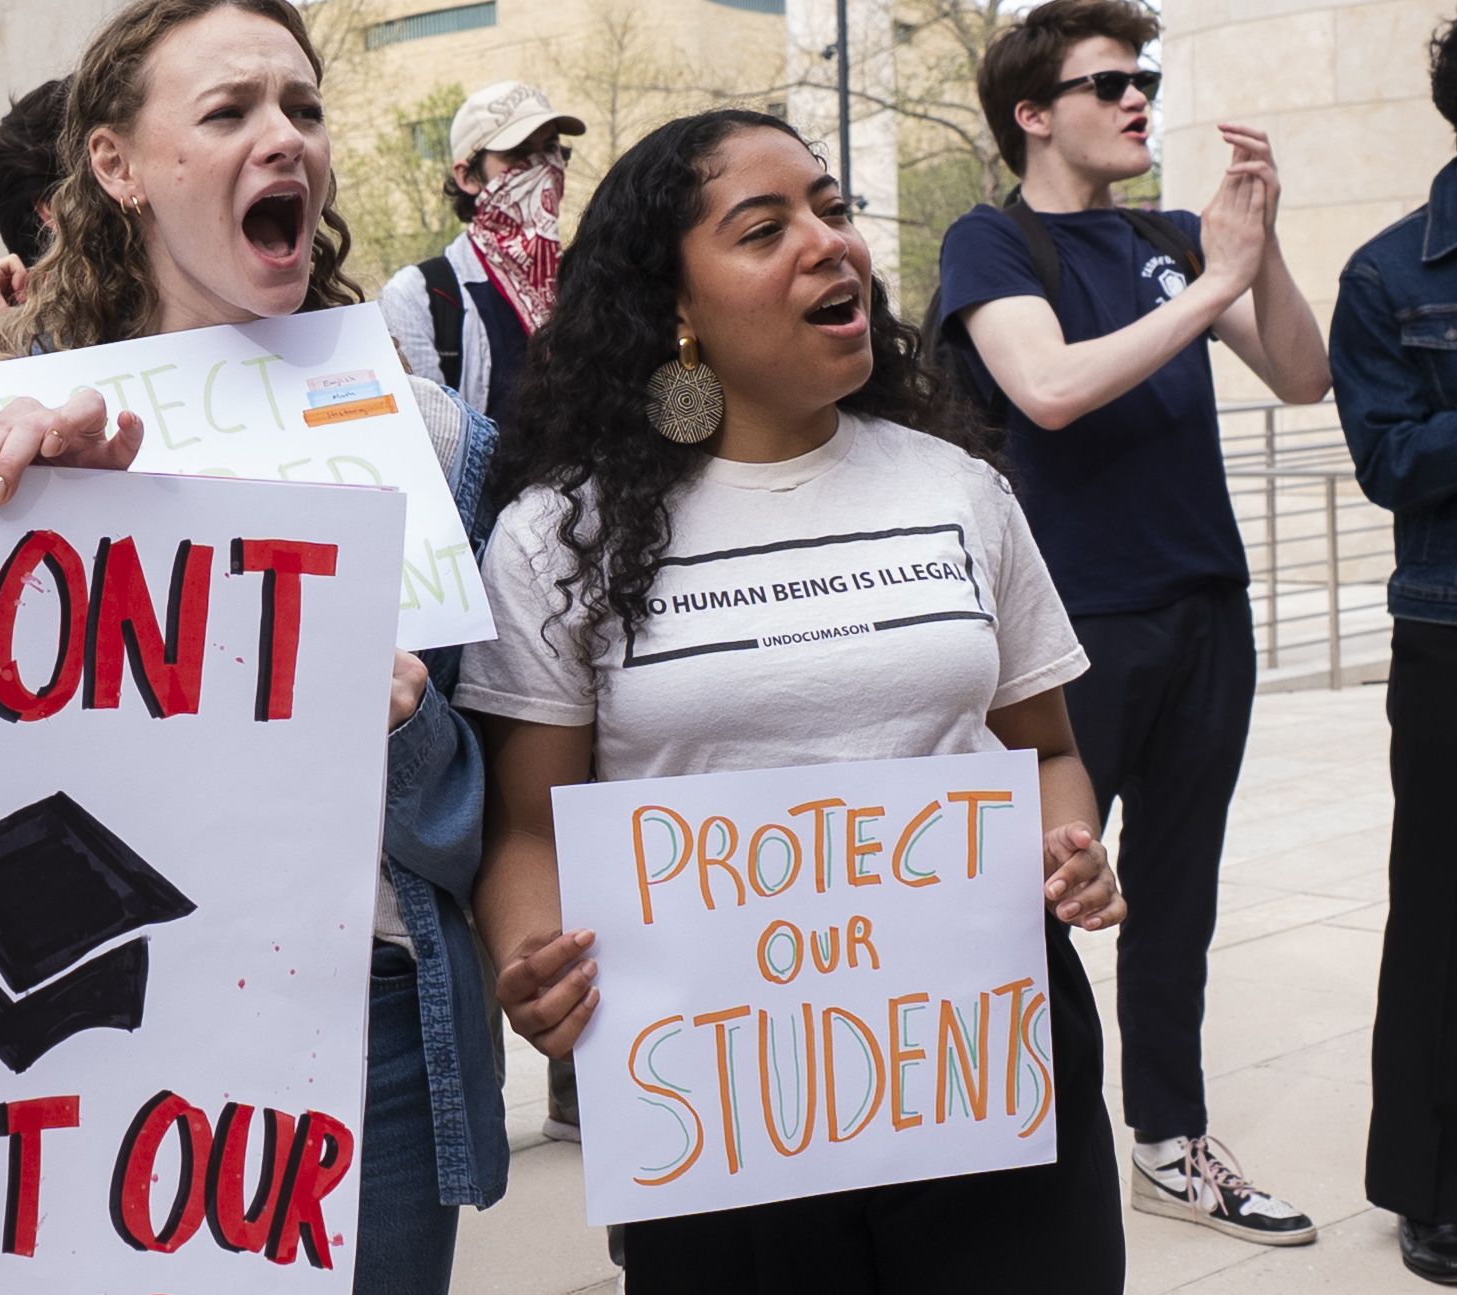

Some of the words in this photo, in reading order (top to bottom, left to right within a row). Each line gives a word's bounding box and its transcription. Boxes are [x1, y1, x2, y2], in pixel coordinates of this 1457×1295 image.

[322, 375, 356, 387] English
[326, 408, 369, 419] History
[672, 584, 768, 614] HUMAN
[772, 573, 849, 602] BEING
[851, 570, 876, 591] IS
[878, 561, 967, 586] ILLEGAL
[762, 623, 870, 648] UNDOCUMASON
[632, 790, 1014, 925] PROTECT
[756, 915, 881, 985] OUR
[627, 977, 1054, 1187] STUDENTS
[109, 1090, 355, 1270] OUR
